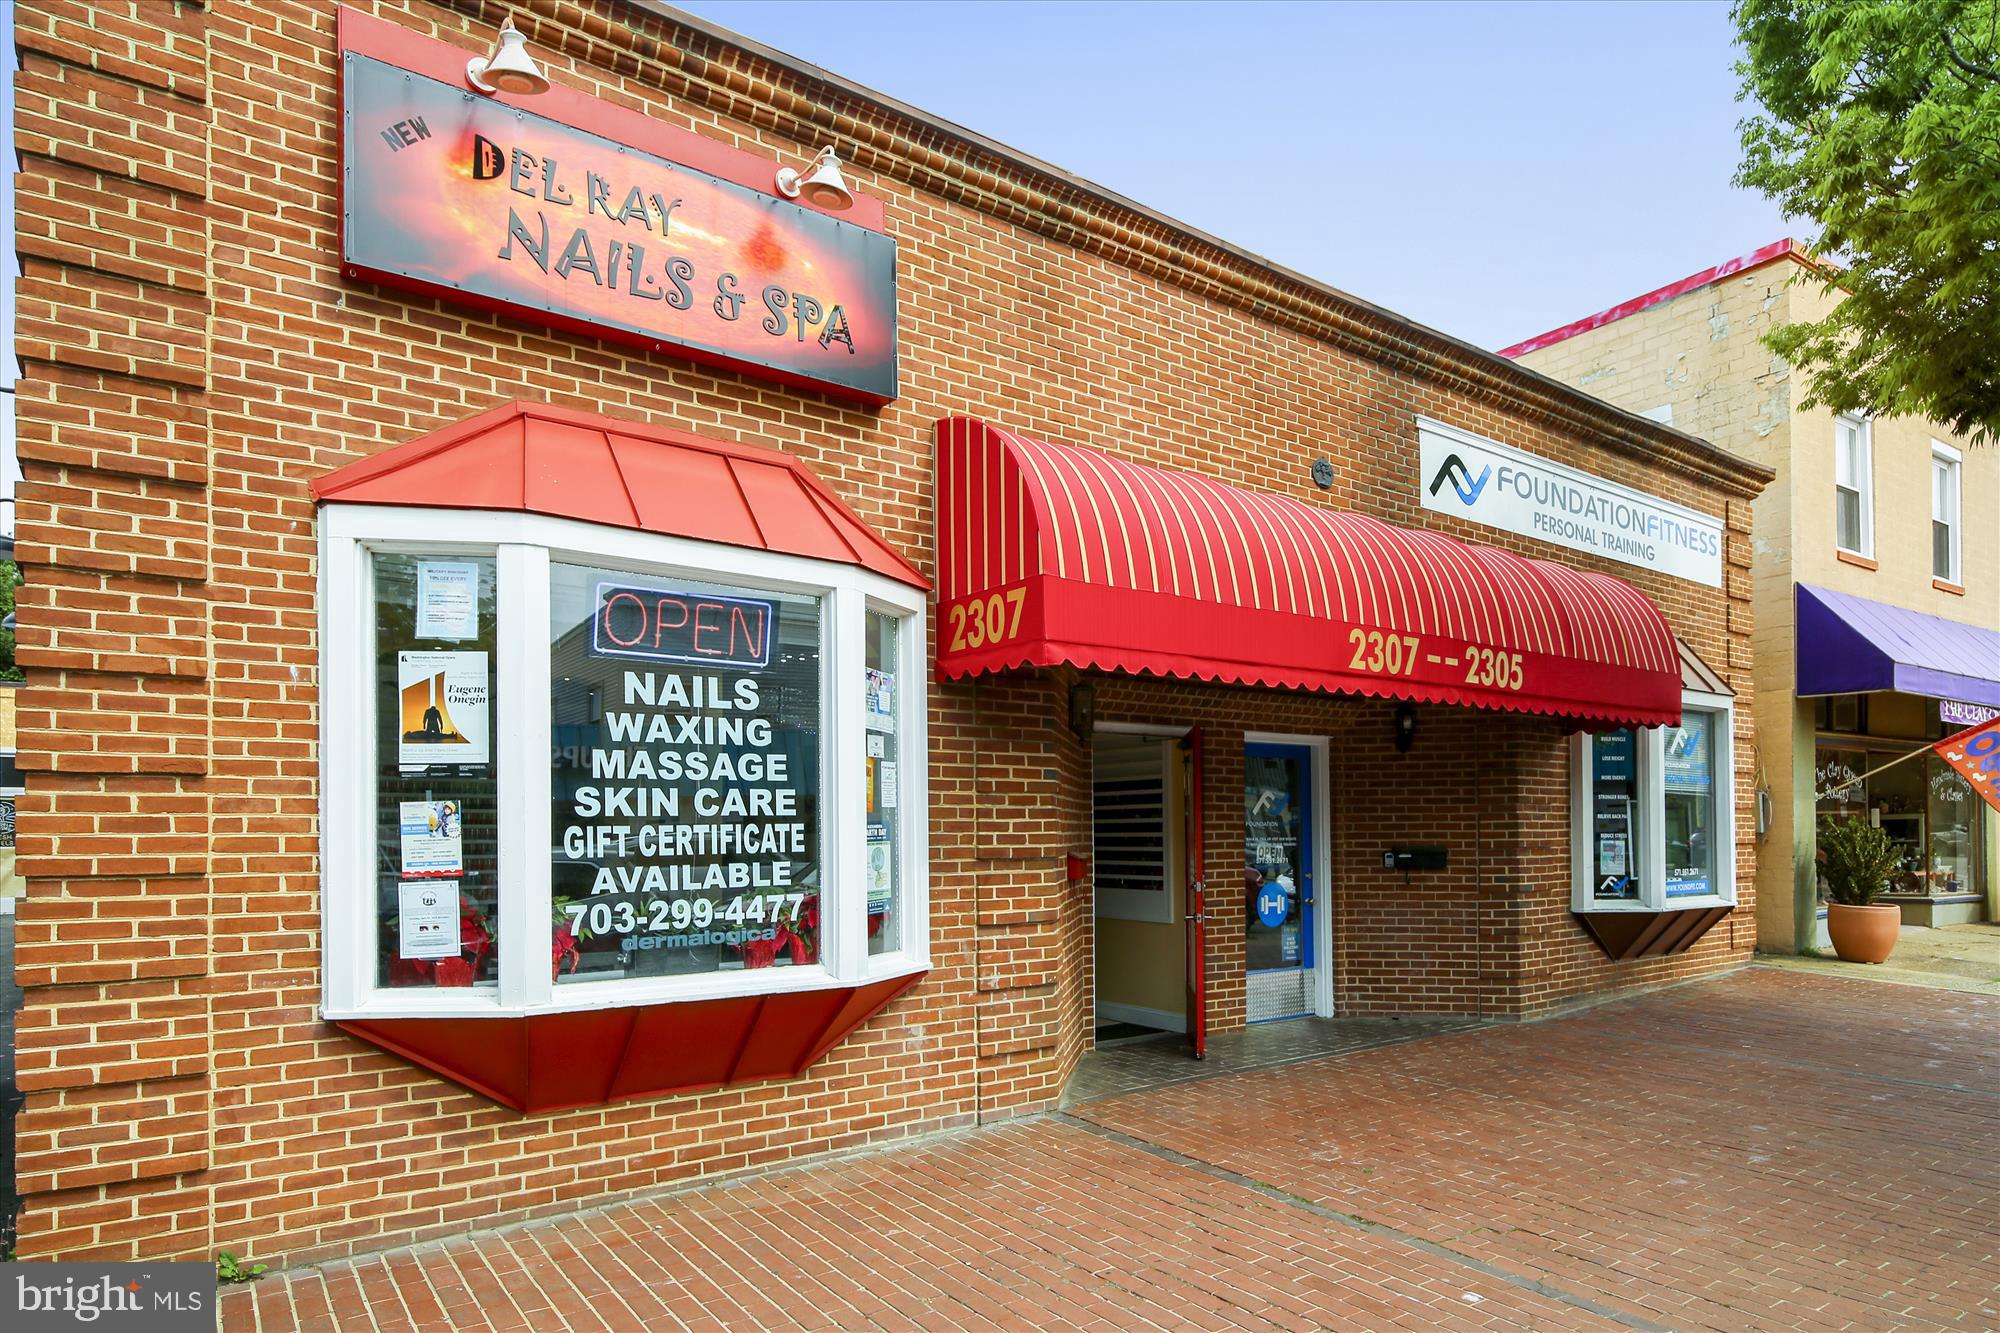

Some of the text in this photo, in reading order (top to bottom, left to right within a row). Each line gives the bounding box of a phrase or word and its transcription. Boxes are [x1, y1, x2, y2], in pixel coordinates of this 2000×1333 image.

[381, 116, 431, 152] NEW
[473, 134, 682, 235] DEL RAY
[498, 207, 854, 353] NAILS & SPA
[1534, 511, 1655, 561] PERSONAL TRAINING
[605, 593, 762, 658] OPEN
[948, 587, 1027, 653] 2307
[1348, 628, 1420, 676] 2307
[1464, 646, 1524, 691] 2305
[448, 685, 486, 696] Eugene
[448, 695, 486, 706] Onegin
[624, 671, 760, 710] NAILS
[1944, 700, 1964, 718] THE
[605, 712, 772, 747] WAXING
[592, 749, 788, 781] MASSAGE
[574, 786, 797, 817] SKIN CARE
[564, 823, 805, 859] GIFT CERTIFICATE
[591, 861, 791, 894] AVAILABLE
[565, 894, 804, 936] 703-299-4477
[620, 926, 776, 951] dermalogica
